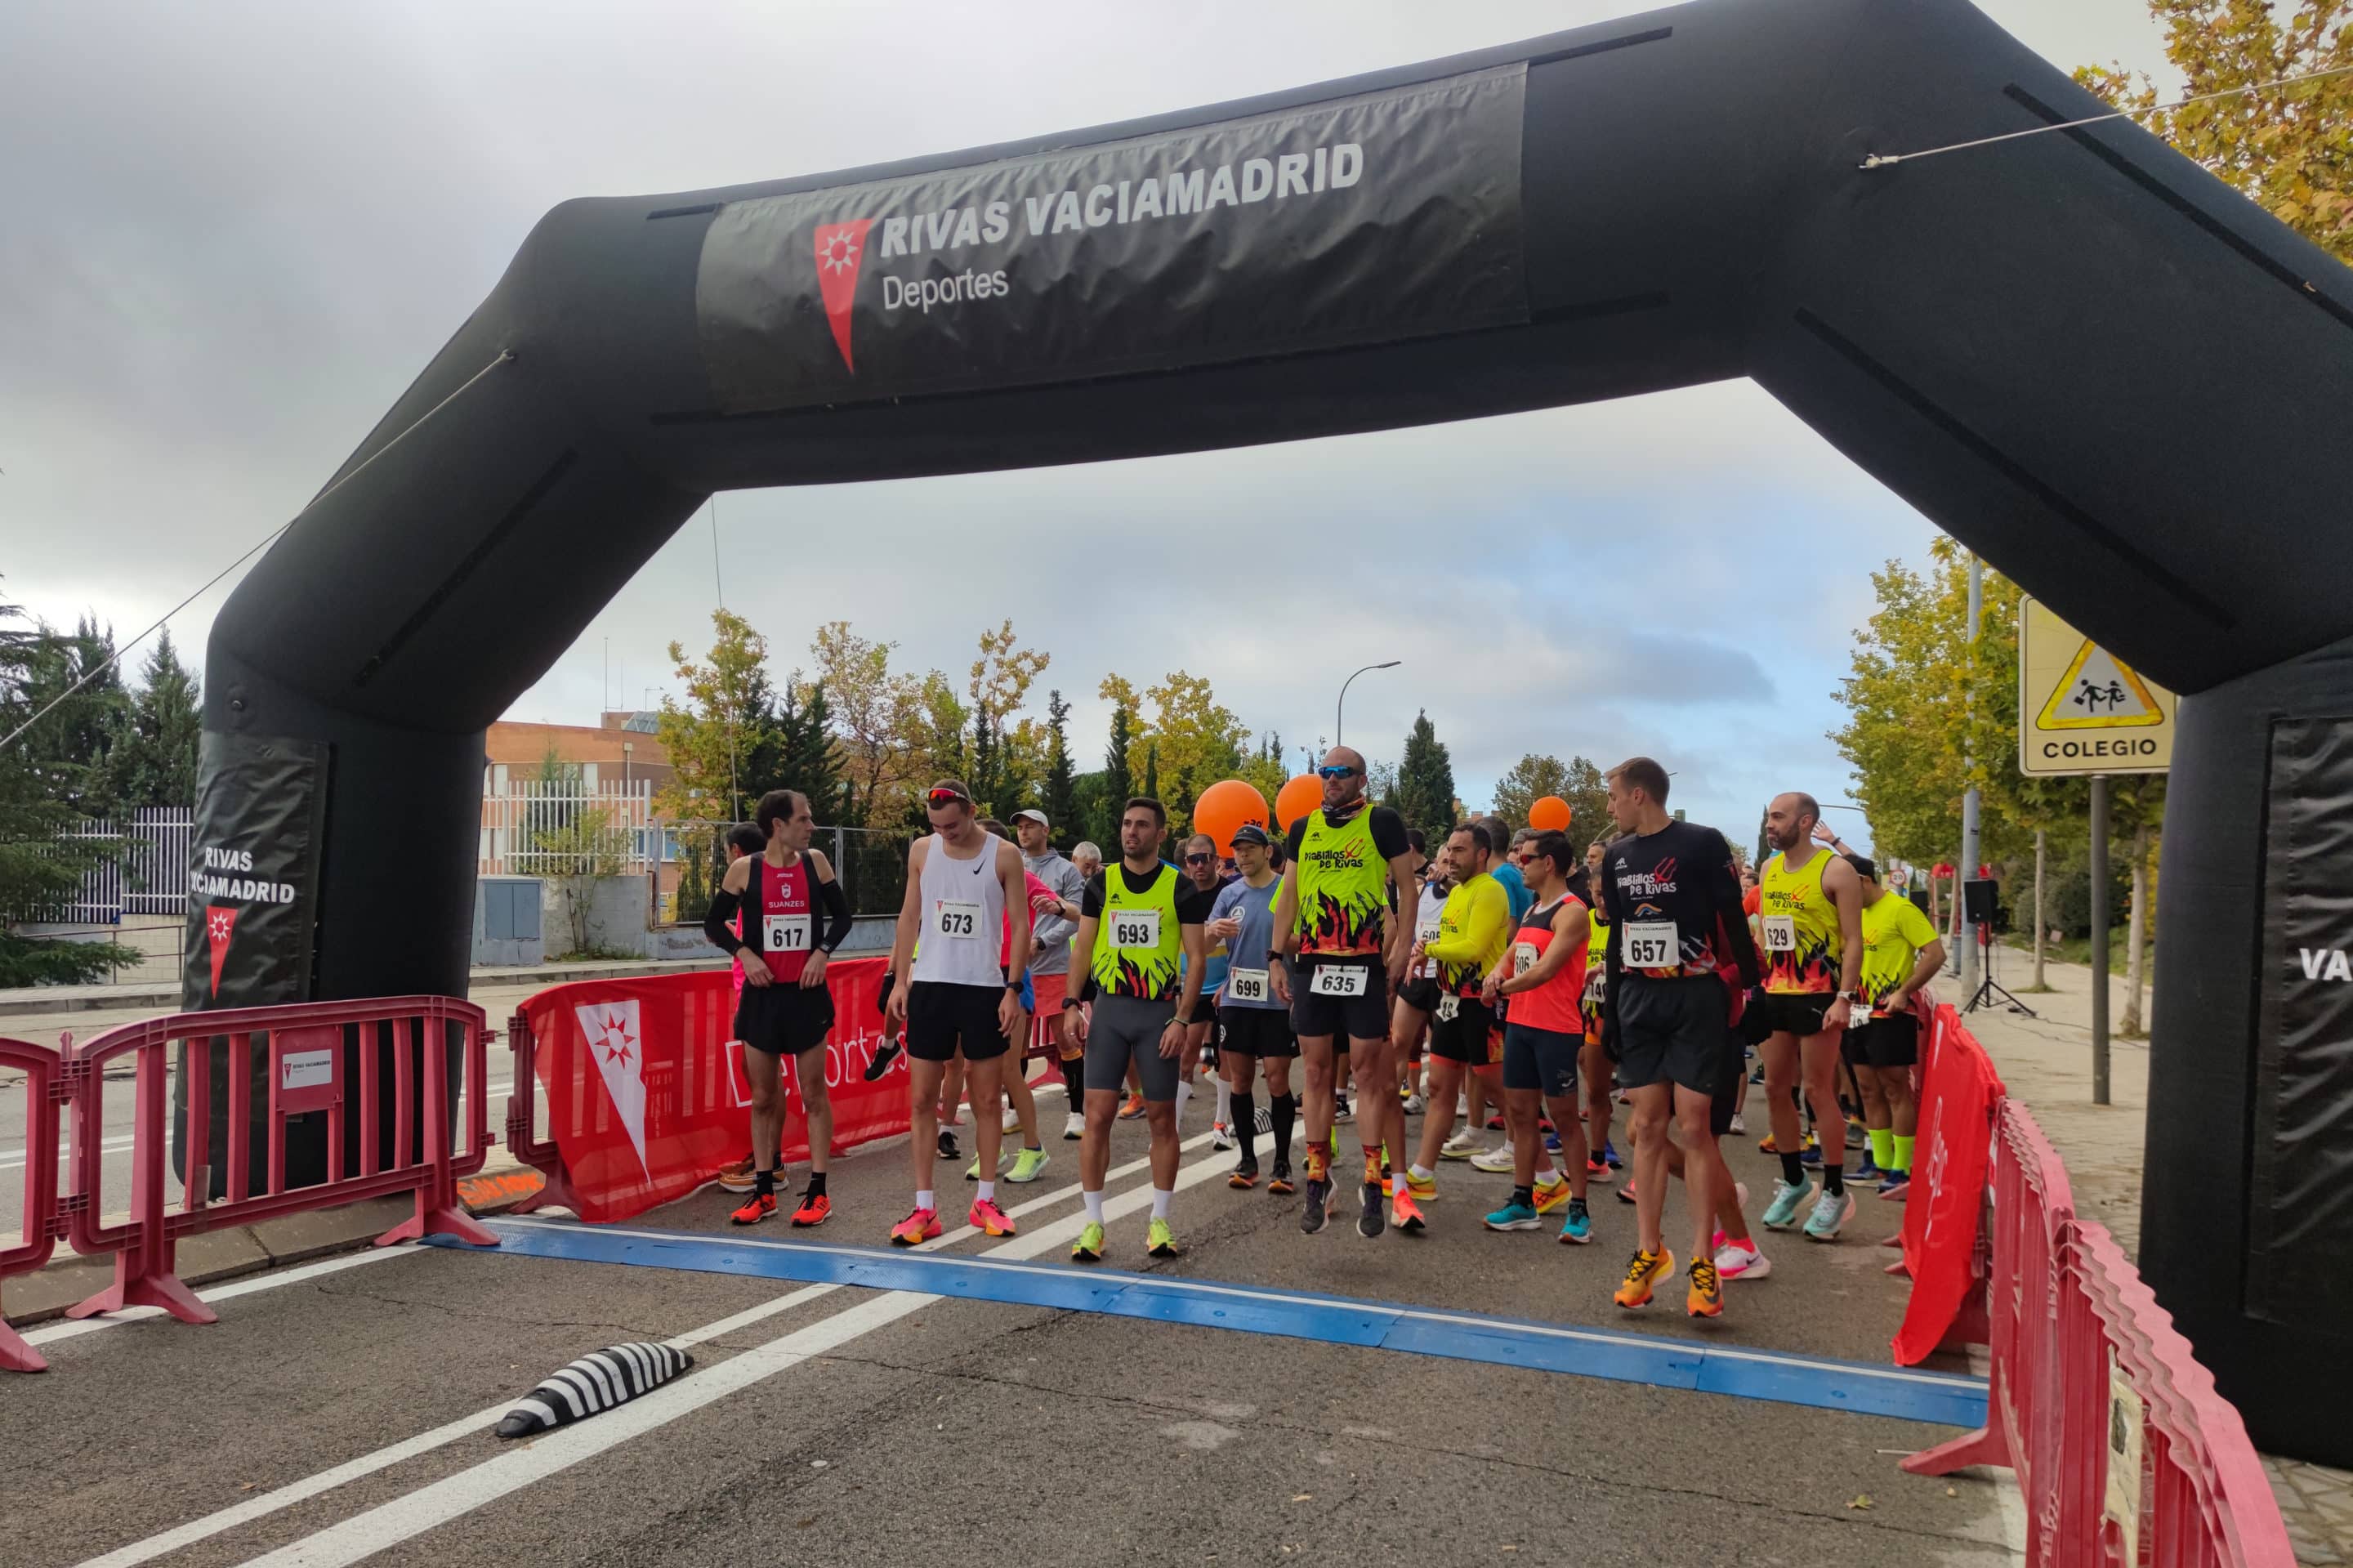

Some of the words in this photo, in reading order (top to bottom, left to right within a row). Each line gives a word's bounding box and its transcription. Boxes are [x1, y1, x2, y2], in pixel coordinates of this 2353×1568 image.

[881, 201, 1010, 258] RIVAS
[1025, 143, 1364, 236] VACIAMADRID
[882, 268, 1009, 314] Deportes
[2043, 739, 2157, 758] COLEGIO
[205, 847, 252, 872] RIVAS
[1335, 859, 1363, 869] Rivas
[190, 870, 295, 904] CIAMADRID
[1645, 882, 1677, 895] Rivas
[942, 914, 972, 934] 673
[1118, 924, 1149, 944] 693
[773, 928, 803, 948] 617
[1767, 927, 1788, 947] 629
[1631, 940, 1667, 963] 657
[1236, 980, 1261, 997] 699
[1321, 975, 1356, 994] 635
